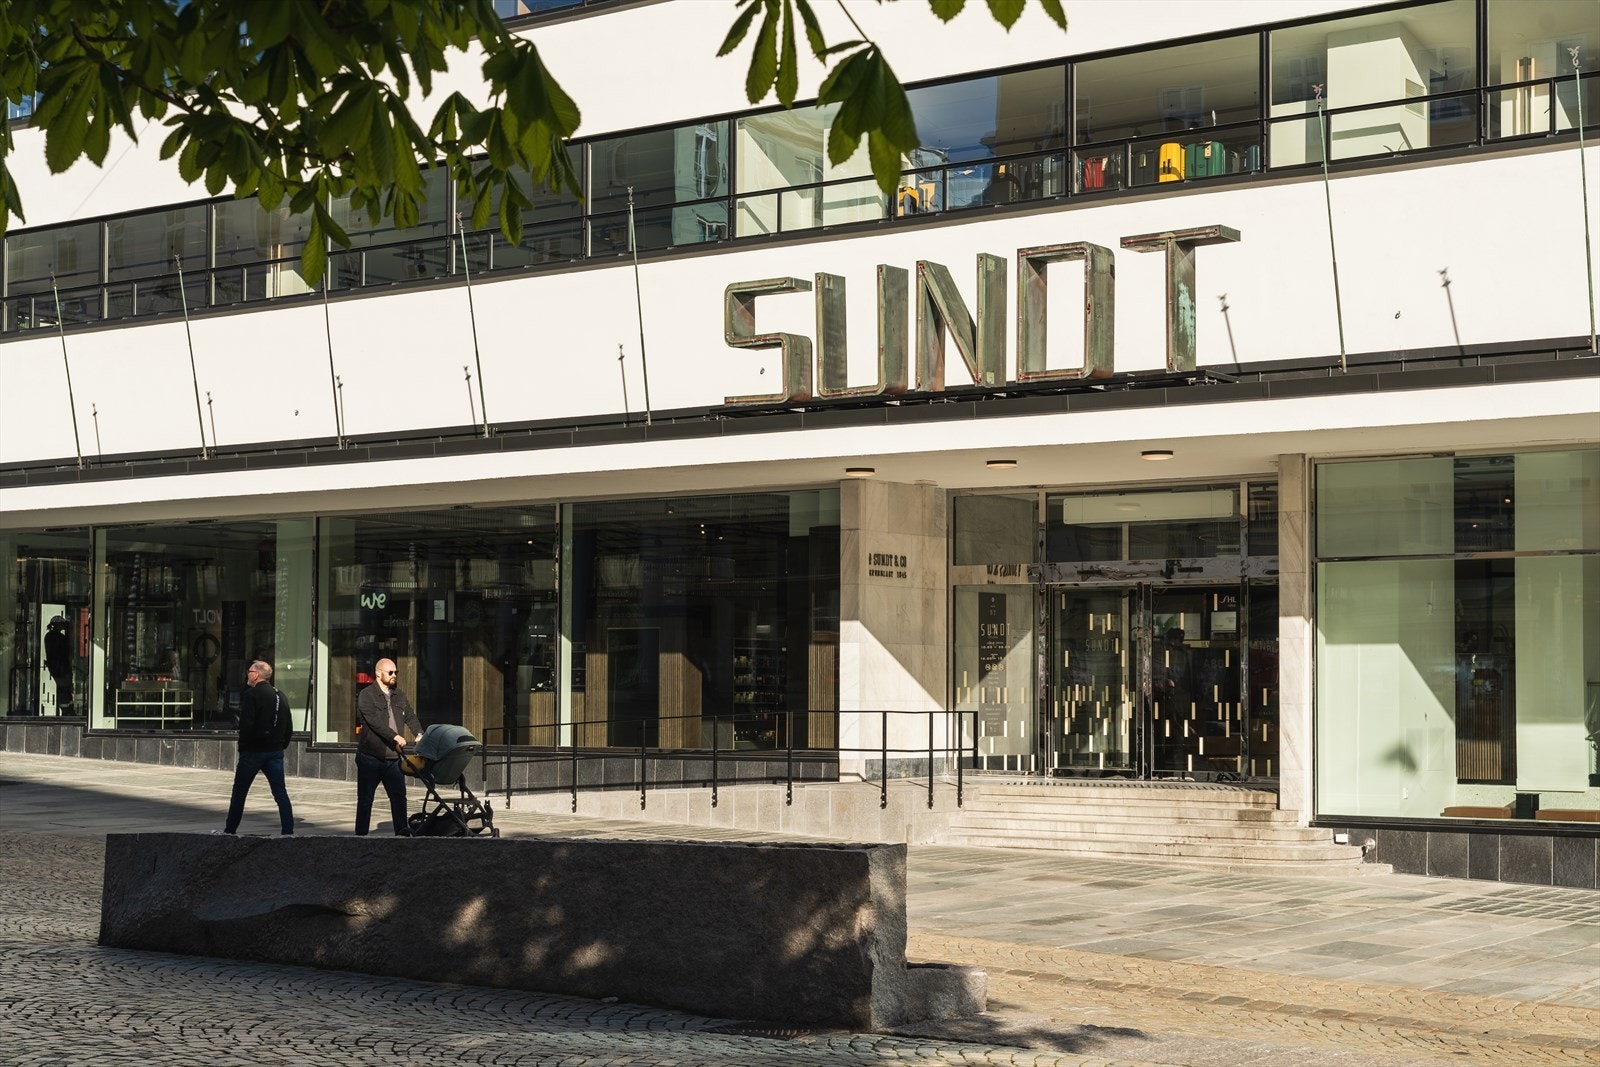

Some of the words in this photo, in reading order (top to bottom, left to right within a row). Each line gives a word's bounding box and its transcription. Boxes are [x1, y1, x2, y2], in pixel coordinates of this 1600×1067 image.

[724, 224, 1241, 406] SUNDT
[360, 591, 387, 610] we
[980, 623, 1011, 637] SUNDT
[1085, 639, 1114, 652] SUNDT
